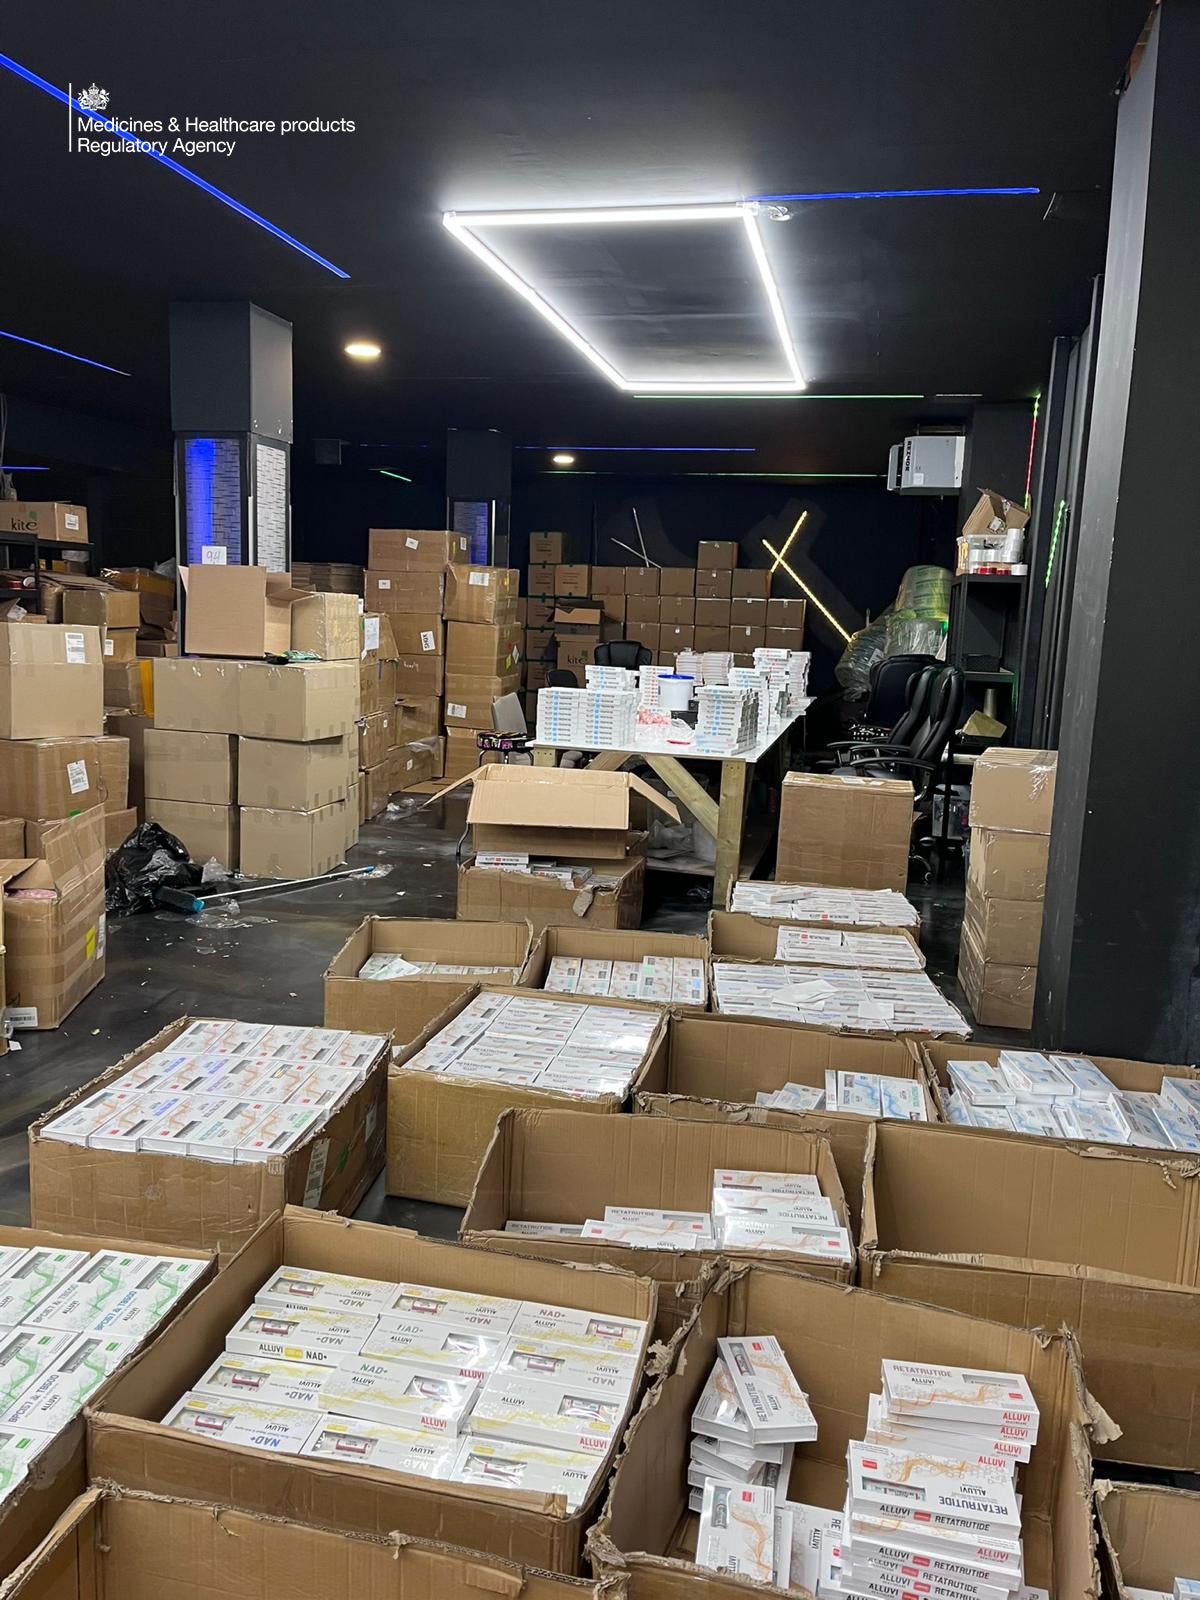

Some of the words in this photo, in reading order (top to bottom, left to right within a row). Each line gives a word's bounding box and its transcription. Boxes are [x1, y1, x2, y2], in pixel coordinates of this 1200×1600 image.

[11, 517, 37, 531] kite
[62, 1300, 79, 1314] ALLUVI
[122, 1307, 139, 1321] ALLUVI
[259, 1343, 283, 1353] ALLUVI
[360, 1363, 388, 1374] NAD+
[893, 1365, 952, 1377] RETATRUTIDE
[352, 1376, 375, 1385] ALLUVI
[459, 1369, 485, 1381] ALLUVI
[299, 1380, 322, 1389] ALLUVI
[41, 1394, 60, 1411] ALLUVI
[502, 1397, 525, 1406] ALLUVI
[421, 1416, 447, 1428] ALLUVI
[1003, 1412, 1030, 1421] ALLUVI
[264, 1424, 289, 1432] ALLUVI
[1000, 1427, 1028, 1437] ALLUVI
[250, 1436, 280, 1447] NAD+
[580, 1437, 607, 1449] ALLUVI
[410, 1447, 435, 1455] ALLUVI
[994, 1443, 1022, 1454] ALLUVI
[978, 1456, 1006, 1467] ALLUVI
[960, 1486, 986, 1496] ALLUVI
[939, 1496, 1009, 1515] RETATRUTIDE
[880, 1505, 910, 1516] ALLUVI
[935, 1515, 990, 1531] RETATRUTIDE
[812, 1528, 820, 1549] ALLUVI
[977, 1548, 1009, 1561] ALLUVI
[879, 1547, 910, 1560] ALLUVI
[934, 1561, 990, 1580] RETATRUTIDE
[880, 1573, 911, 1586] ALLUVI
[922, 1572, 978, 1594] RETATRUTIDE
[869, 1583, 899, 1596] ALLUVI
